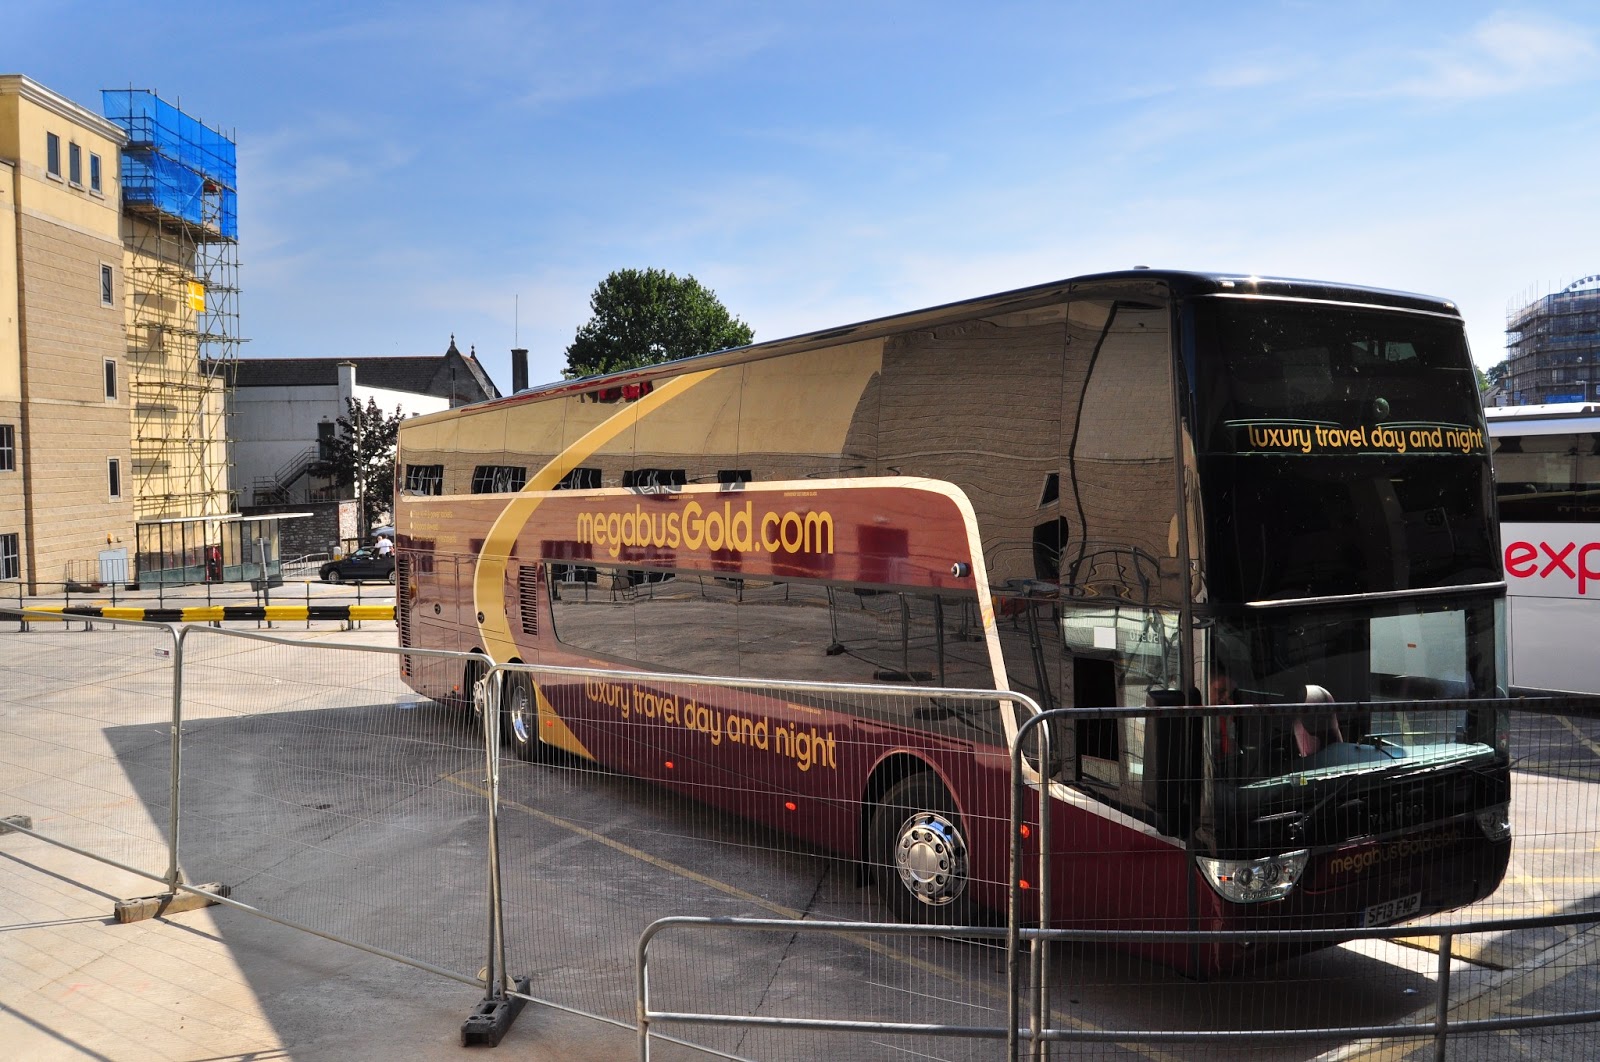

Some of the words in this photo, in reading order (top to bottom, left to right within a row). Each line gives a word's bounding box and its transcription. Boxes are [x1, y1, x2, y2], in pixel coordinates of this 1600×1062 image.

[1248, 425, 1312, 453] luxury
[1315, 425, 1368, 448] travel
[1372, 426, 1407, 453] day
[1410, 427, 1443, 448] and
[1447, 427, 1484, 453] night
[576, 501, 834, 557] megabusGold.com
[586, 676, 630, 719] luxury
[633, 687, 681, 725] travel
[684, 699, 722, 746] day
[726, 716, 769, 751] and
[775, 722, 836, 772] night
